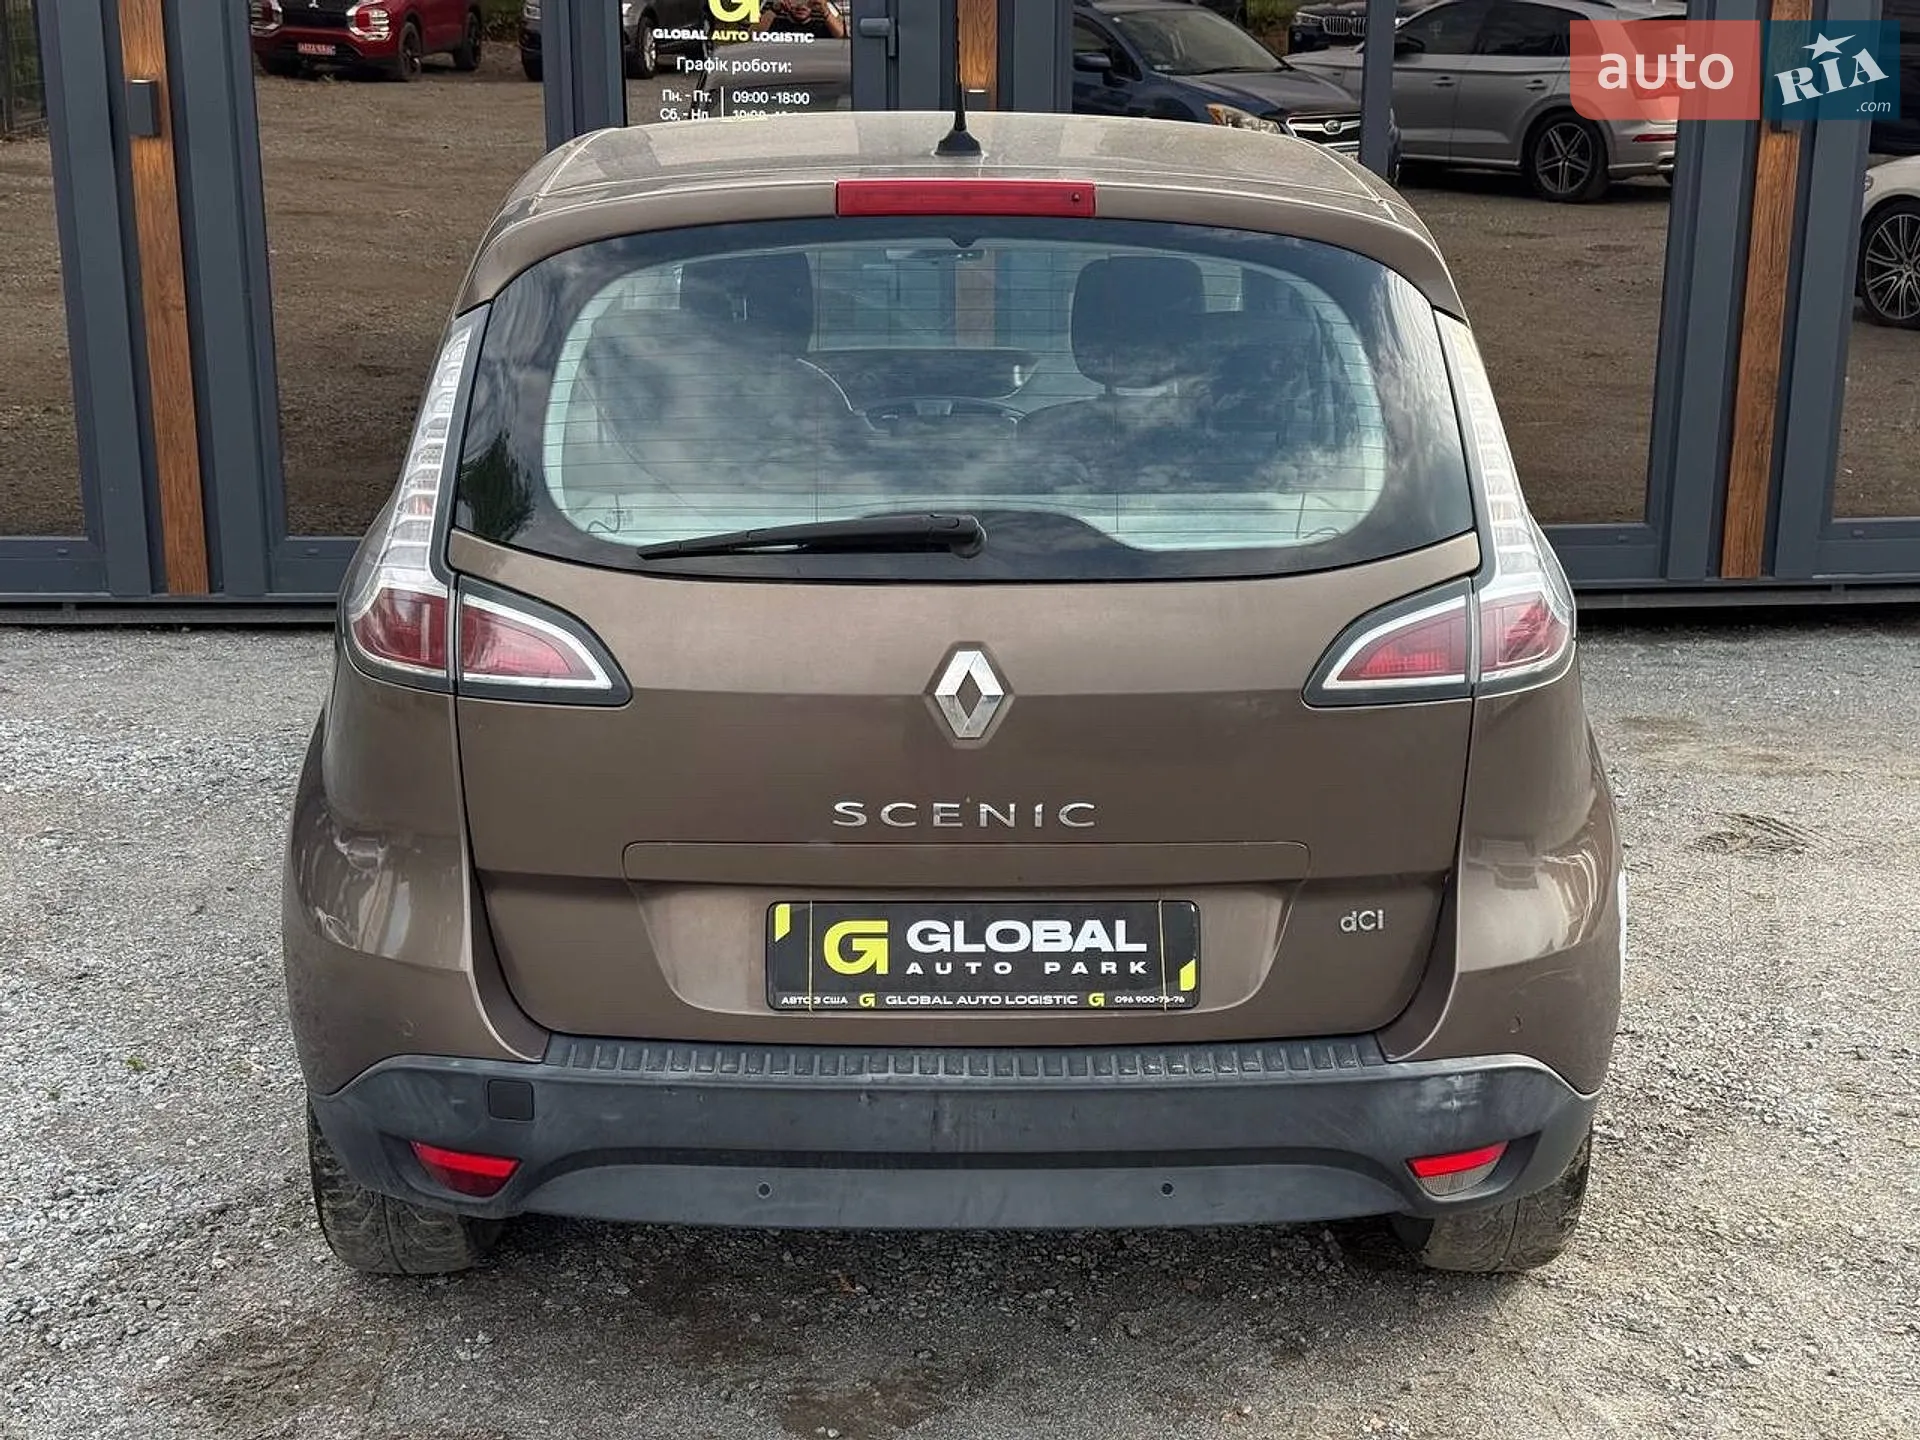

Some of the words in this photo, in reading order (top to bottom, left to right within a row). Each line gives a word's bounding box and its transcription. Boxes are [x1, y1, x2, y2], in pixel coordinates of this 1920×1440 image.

[652, 28, 708, 41] GLOBAL
[711, 30, 749, 41] AUTO
[752, 32, 814, 43] LOGISTIC
[676, 57, 728, 73] Графік
[732, 58, 792, 75] роботи:
[662, 89, 682, 102] Пн.
[693, 90, 712, 103] Пт.
[732, 91, 769, 103] 09:00
[832, 802, 1096, 828] SCENIC
[906, 920, 1147, 953] GLOBAL
[906, 961, 1013, 975] AUTO
[1044, 961, 1147, 975] PARK
[885, 995, 953, 1005] GLOBAL
[956, 995, 1002, 1005] AUTO
[1005, 995, 1079, 1005] LOGISTIC
[1114, 995, 1134, 1004] 096
